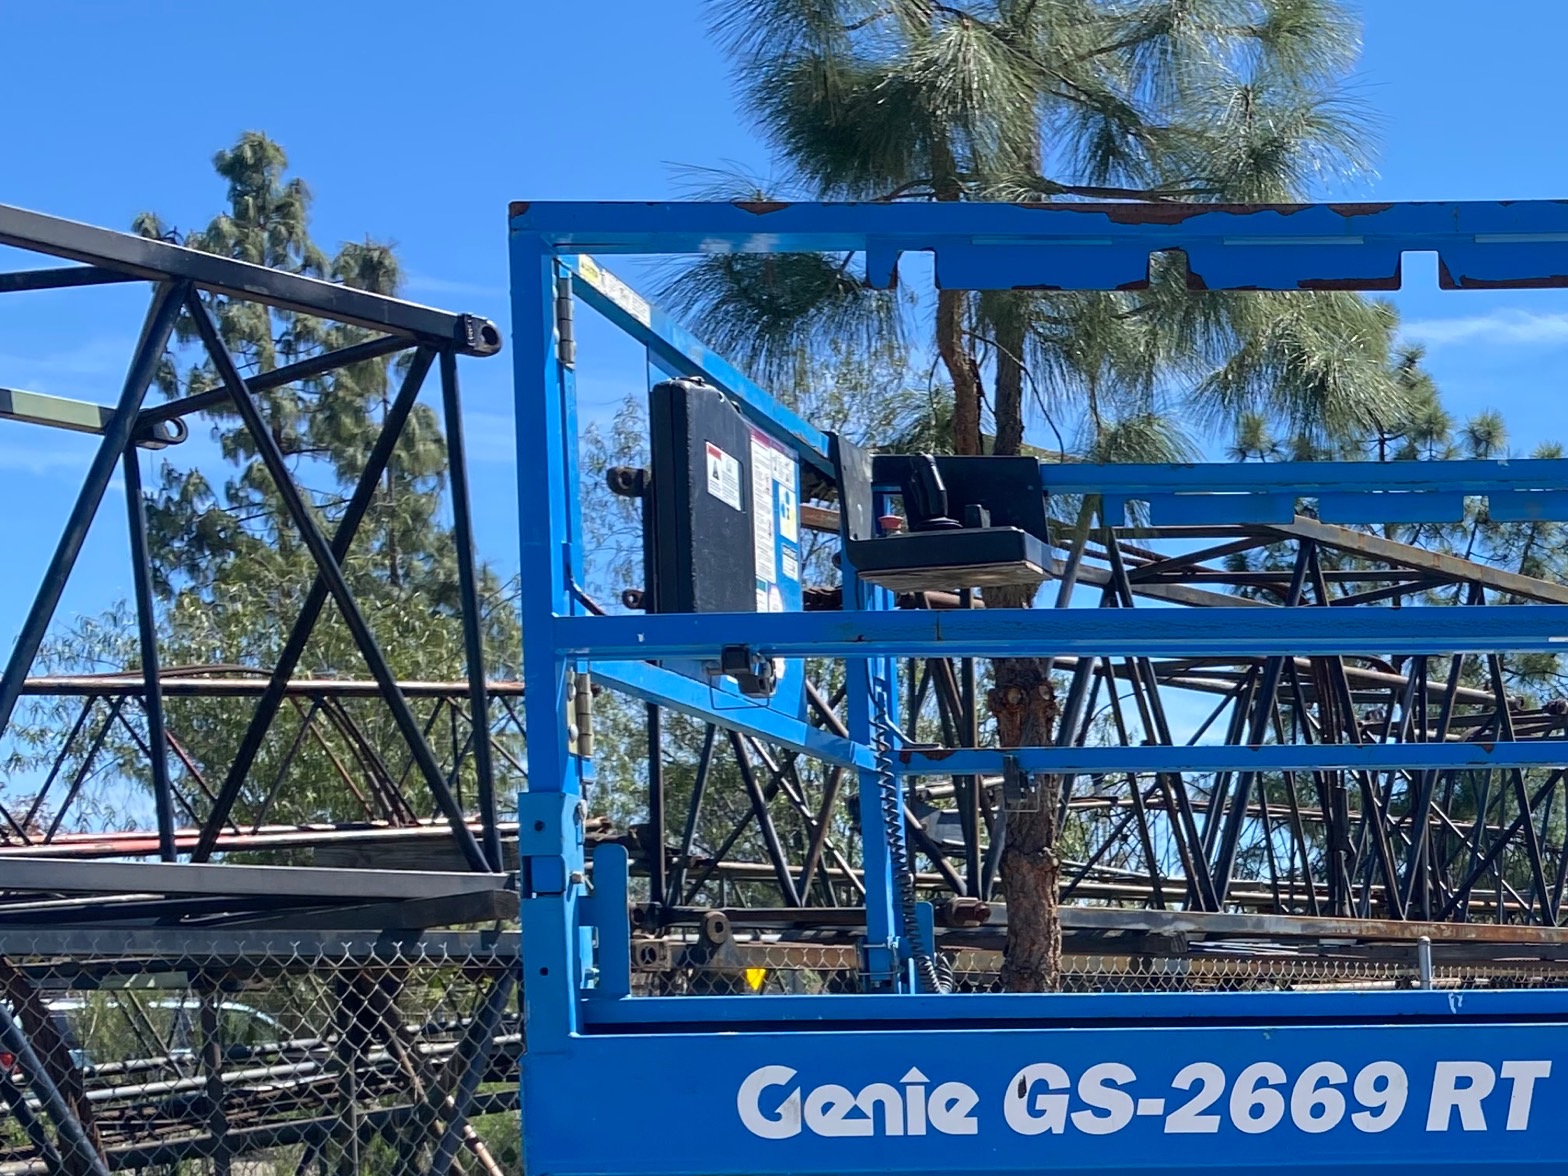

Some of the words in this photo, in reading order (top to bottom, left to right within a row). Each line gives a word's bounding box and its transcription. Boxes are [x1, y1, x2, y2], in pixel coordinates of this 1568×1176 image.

[737, 1065, 979, 1139] Genie
[1003, 1061, 1408, 1135] GS-2669
[1425, 1060, 1552, 1131] RT
